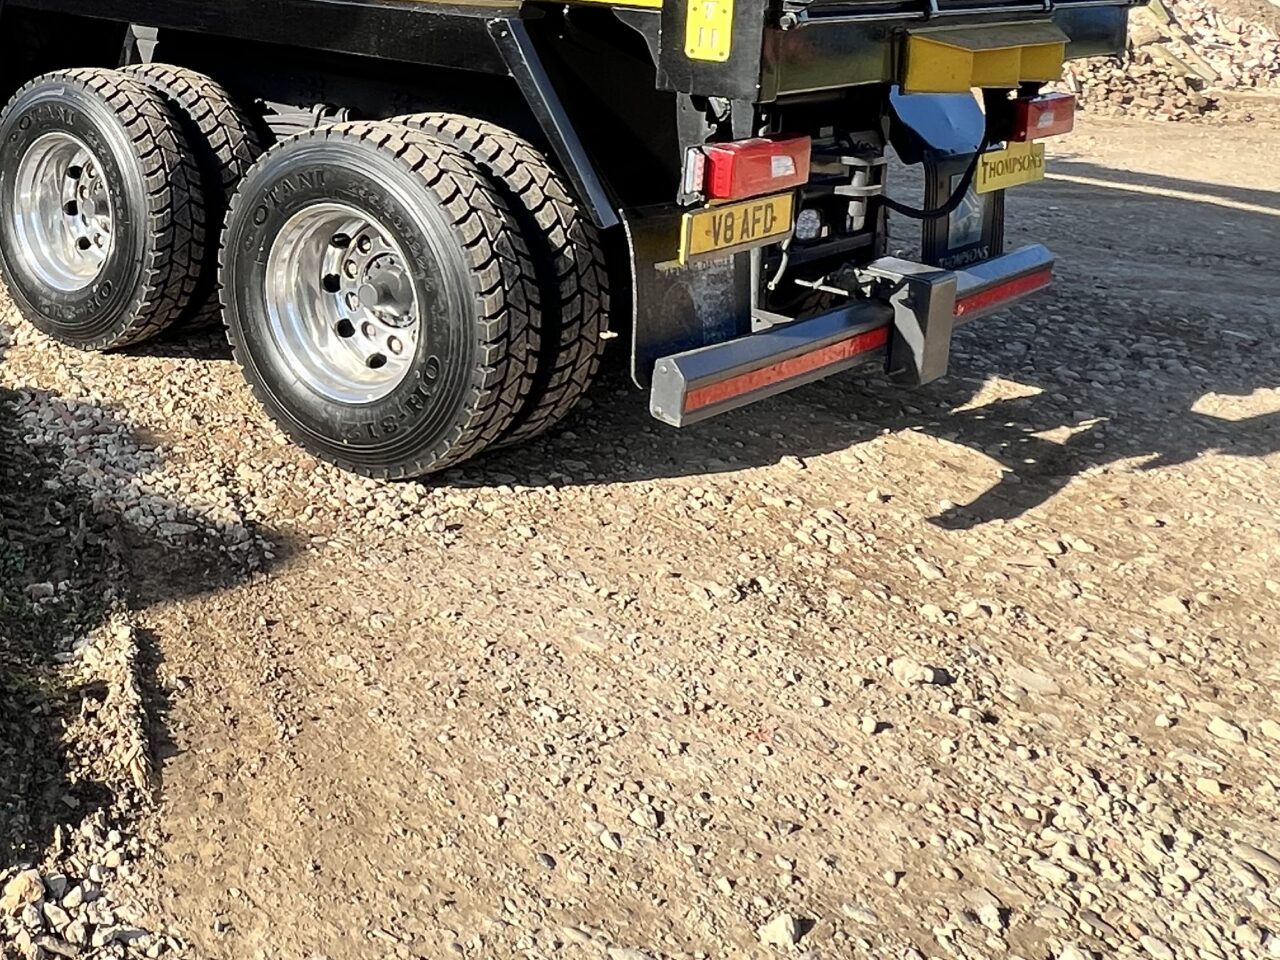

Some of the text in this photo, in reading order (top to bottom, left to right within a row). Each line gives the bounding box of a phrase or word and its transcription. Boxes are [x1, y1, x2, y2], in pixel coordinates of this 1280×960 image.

[981, 153, 1042, 185] THOMPSONS
[253, 170, 325, 226] OTANI
[712, 203, 774, 246] V8 AFD
